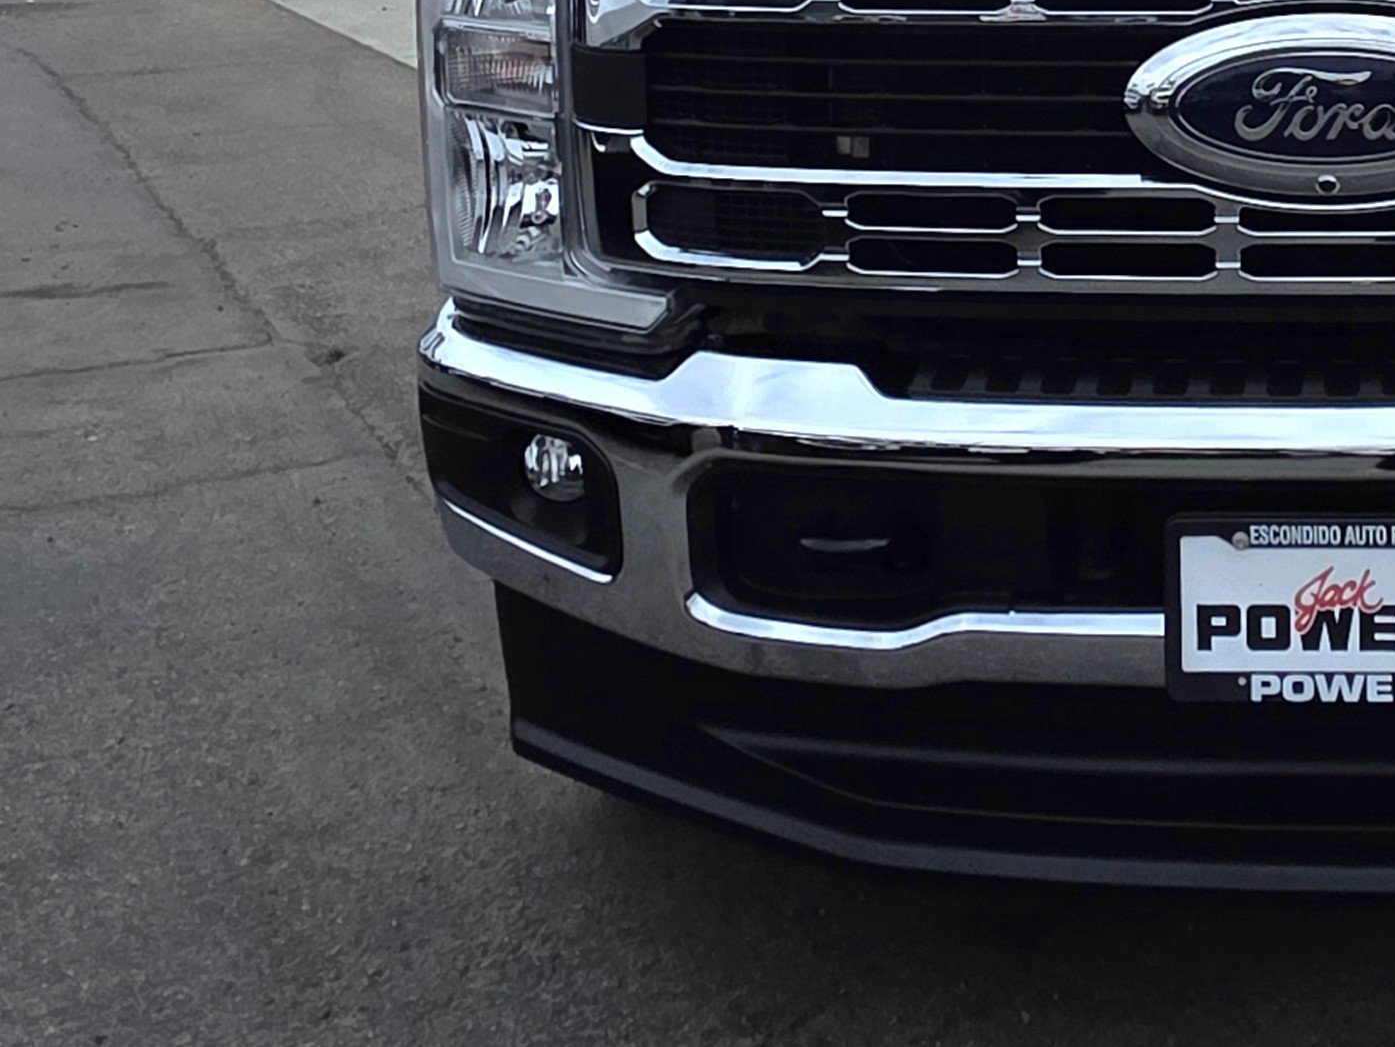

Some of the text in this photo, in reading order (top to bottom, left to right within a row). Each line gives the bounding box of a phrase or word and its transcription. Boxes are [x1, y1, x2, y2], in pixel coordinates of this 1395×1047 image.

[1249, 525, 1340, 546] ESCONDIDO
[1344, 525, 1387, 546] AUTO
[1294, 566, 1384, 632] Jack
